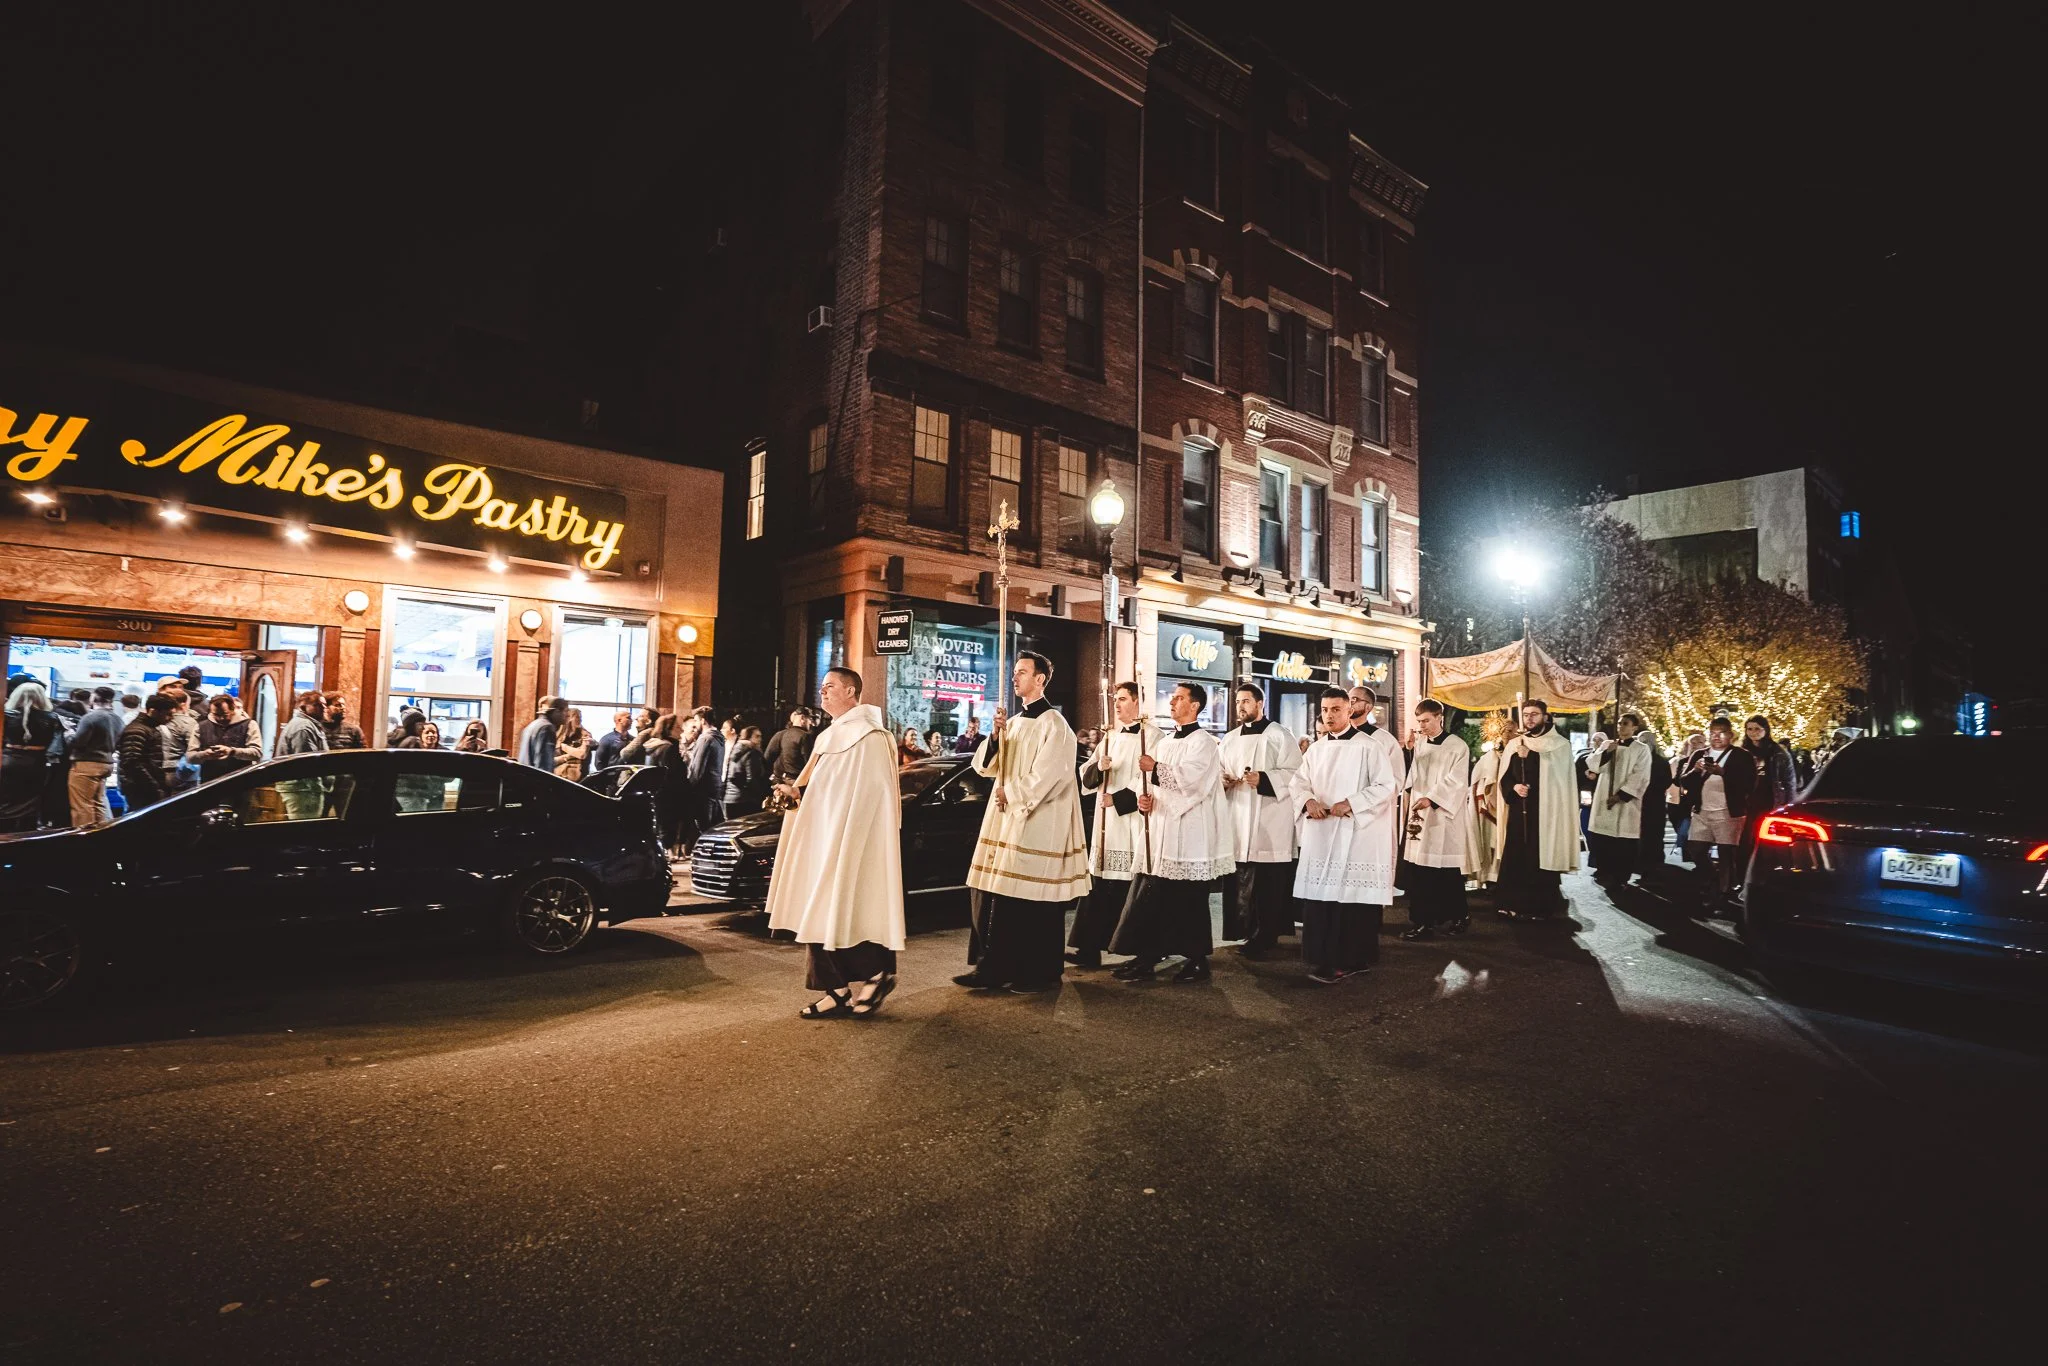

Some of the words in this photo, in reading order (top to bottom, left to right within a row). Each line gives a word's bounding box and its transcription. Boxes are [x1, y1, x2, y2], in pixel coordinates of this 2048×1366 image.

[120, 414, 404, 510] Mike's
[412, 463, 624, 570] Pastry
[117, 619, 152, 632] 300
[881, 615, 909, 624] HANOVER
[887, 627, 900, 636] DRY
[878, 639, 909, 648] CLEANERS
[931, 653, 963, 668] DRY
[904, 667, 987, 685] CLEANERS
